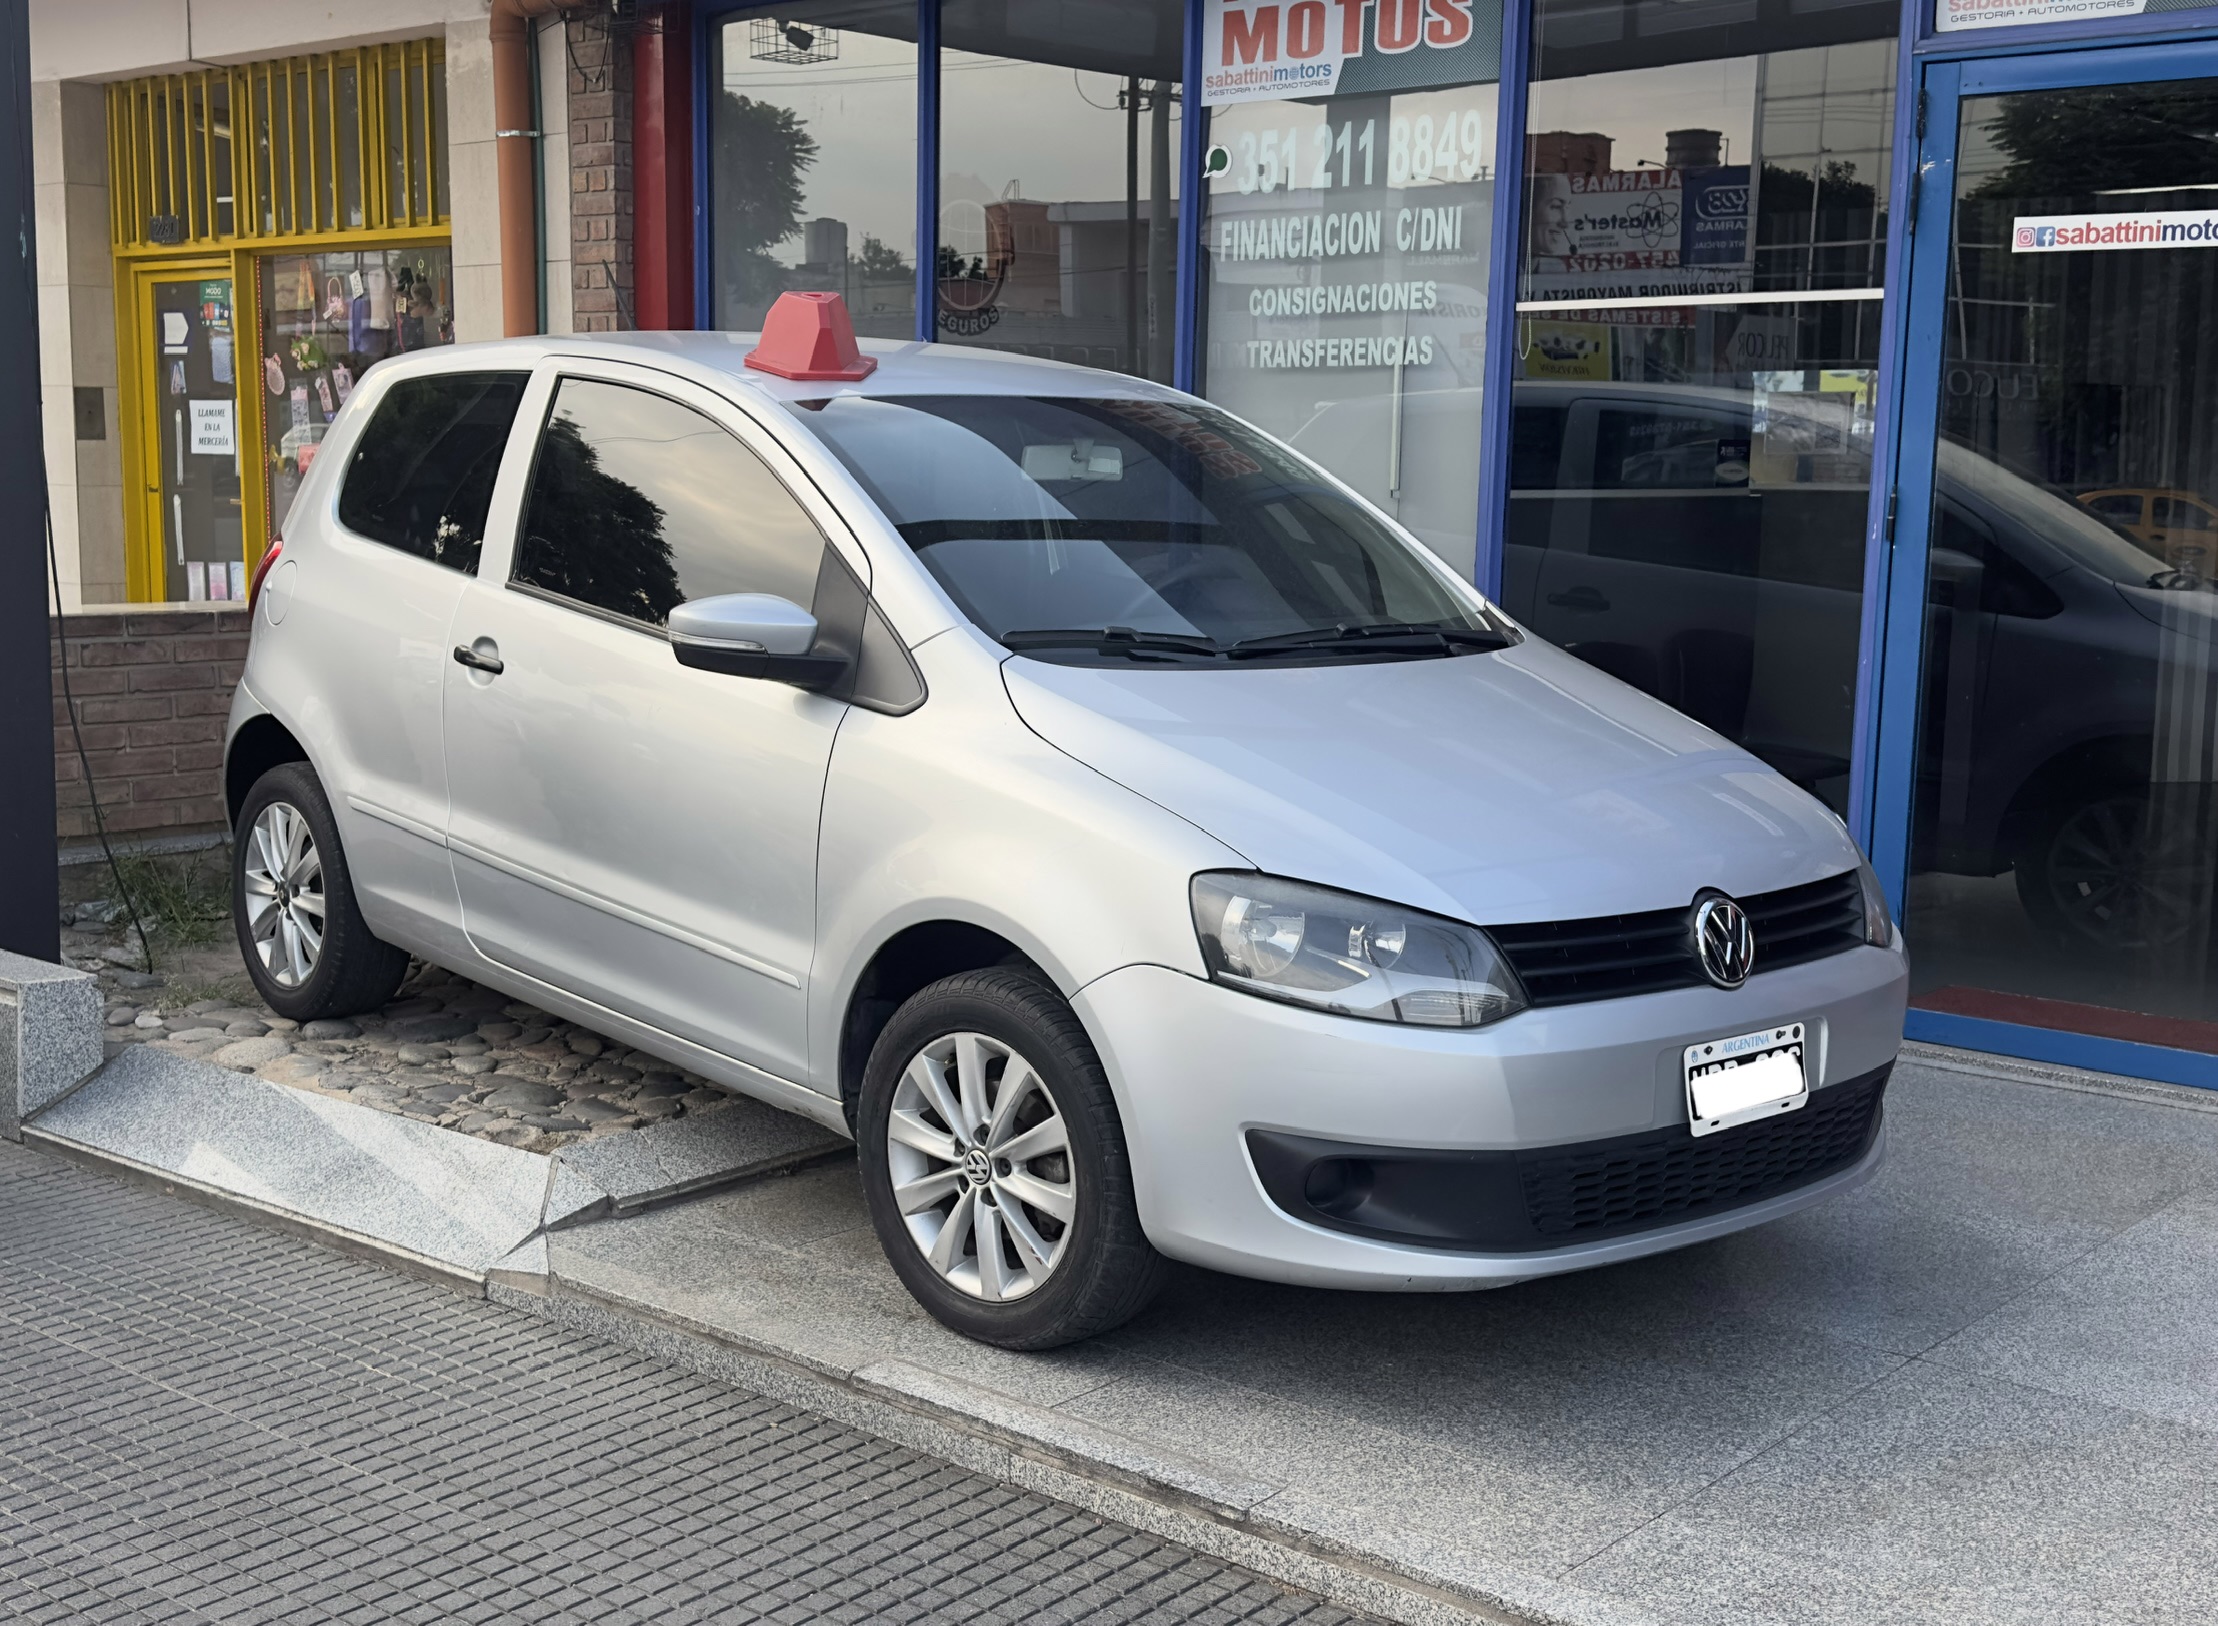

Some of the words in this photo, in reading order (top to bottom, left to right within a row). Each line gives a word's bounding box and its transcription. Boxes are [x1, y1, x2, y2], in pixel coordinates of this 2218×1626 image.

[1950, 9, 2015, 23] GESTORIA
[2027, 0, 2135, 16] AUTOMOTORES
[1207, 87, 1251, 97] GESTORIA
[1259, 79, 1330, 92] AUTOMOTORES
[1238, 127, 1296, 195] 351
[1311, 119, 1376, 189] 211
[1388, 109, 1483, 184] 8849
[1220, 210, 1381, 262] FINANCIACION
[1396, 206, 1463, 252] C/DNI
[1249, 280, 1438, 316] CONSIGNACIONES
[1247, 336, 1433, 369] TRANSFERENCIAS
[1721, 1034, 1770, 1054] ARGENTINA
